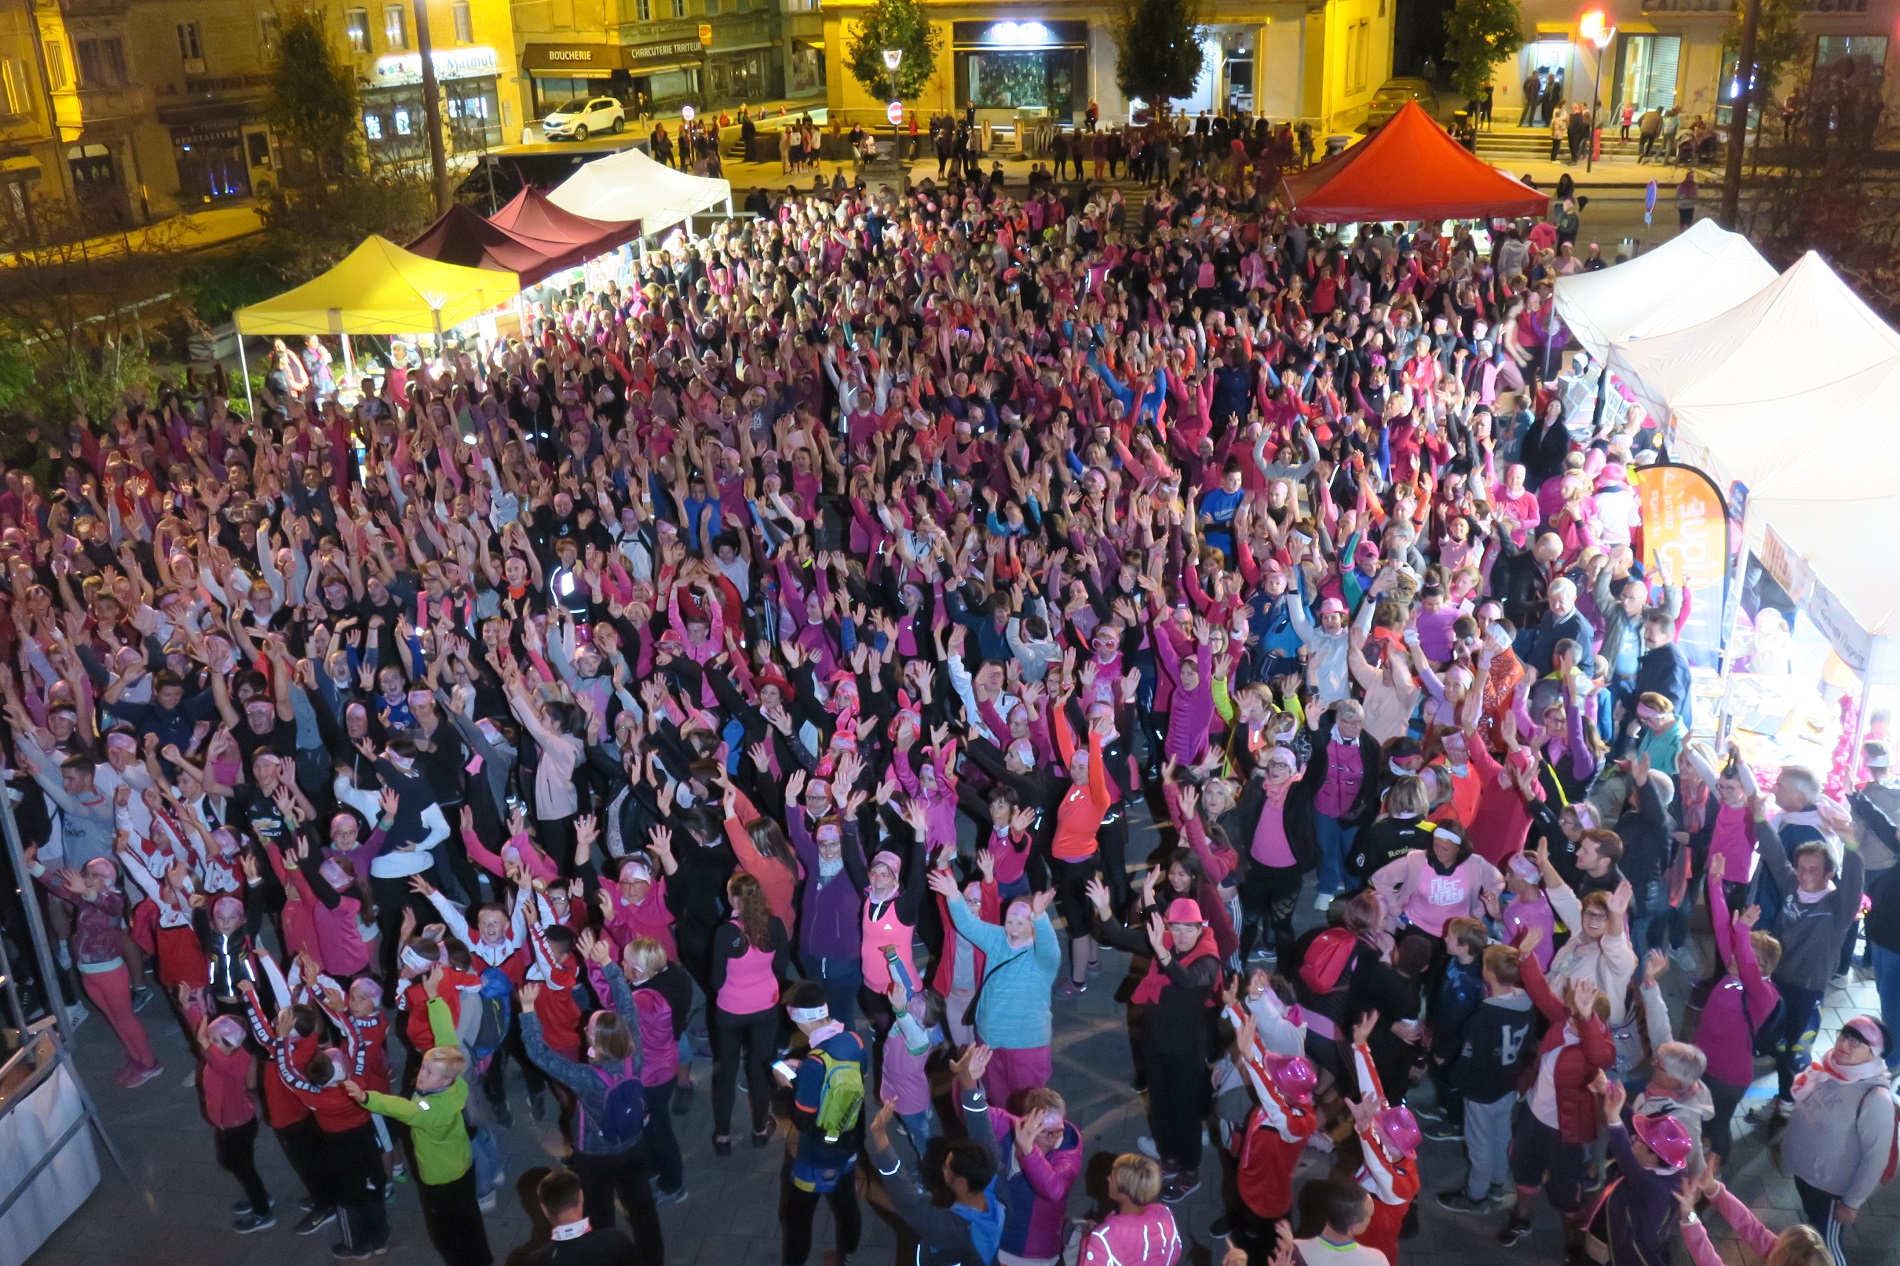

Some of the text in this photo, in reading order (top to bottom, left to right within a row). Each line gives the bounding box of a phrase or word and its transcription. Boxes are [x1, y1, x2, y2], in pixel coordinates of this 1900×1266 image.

[549, 50, 592, 61] BOUCHERIE
[631, 42, 702, 58] CHARCUTERIE TRAITEUR
[447, 53, 494, 72] Matmut
[1430, 877, 1462, 894] FREE
[1428, 887, 1465, 906] ENERGY
